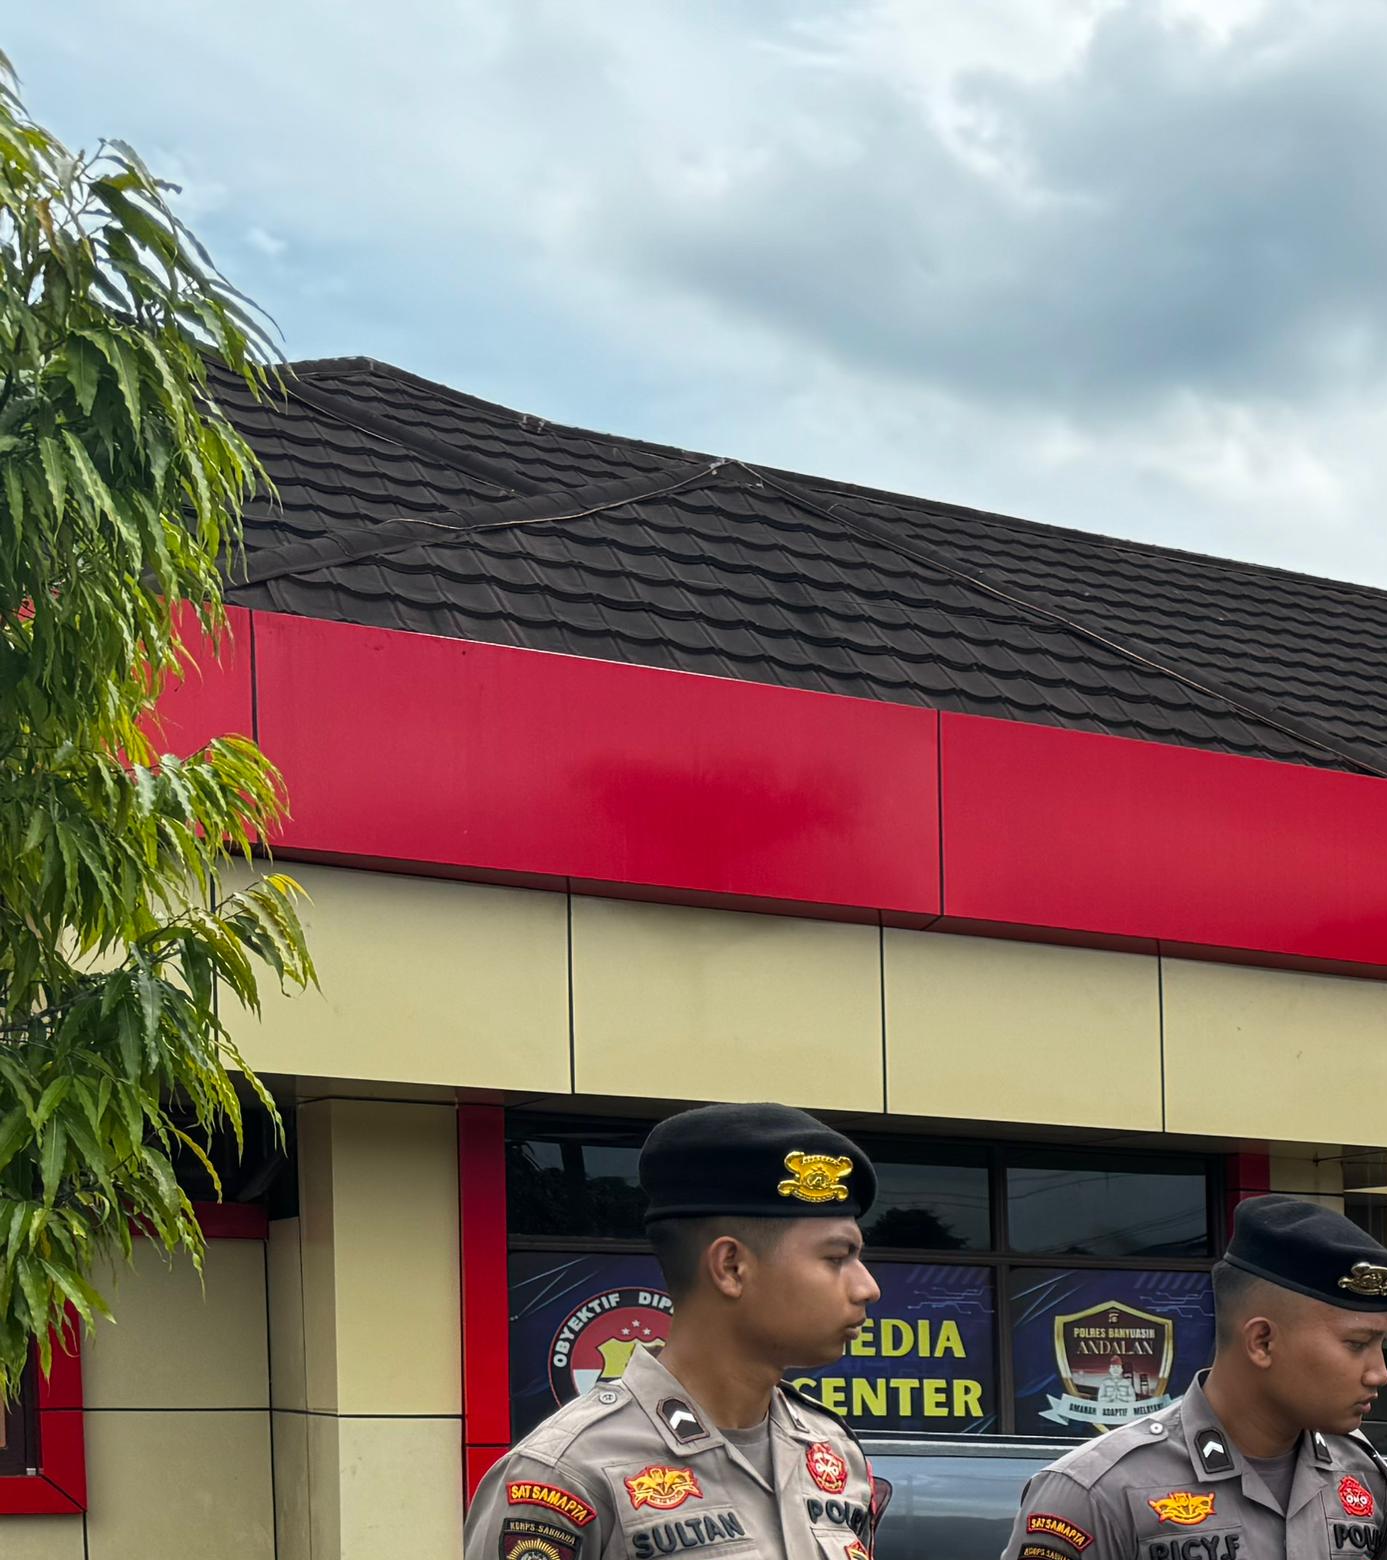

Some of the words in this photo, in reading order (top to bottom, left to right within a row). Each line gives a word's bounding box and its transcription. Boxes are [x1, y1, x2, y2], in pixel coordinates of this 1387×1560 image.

[553, 1293, 620, 1367] OBYEKTIF
[842, 1318, 967, 1358] EDIA
[1074, 1327, 1105, 1338] POLRES
[1108, 1328, 1155, 1338] BANYUASIN
[1077, 1340, 1153, 1355] ANDALAN
[511, 1485, 530, 1499] SAT
[532, 1486, 589, 1521] SAMAPTA
[632, 1511, 745, 1559] SULTAN
[1045, 1519, 1086, 1545] SAMAPTA
